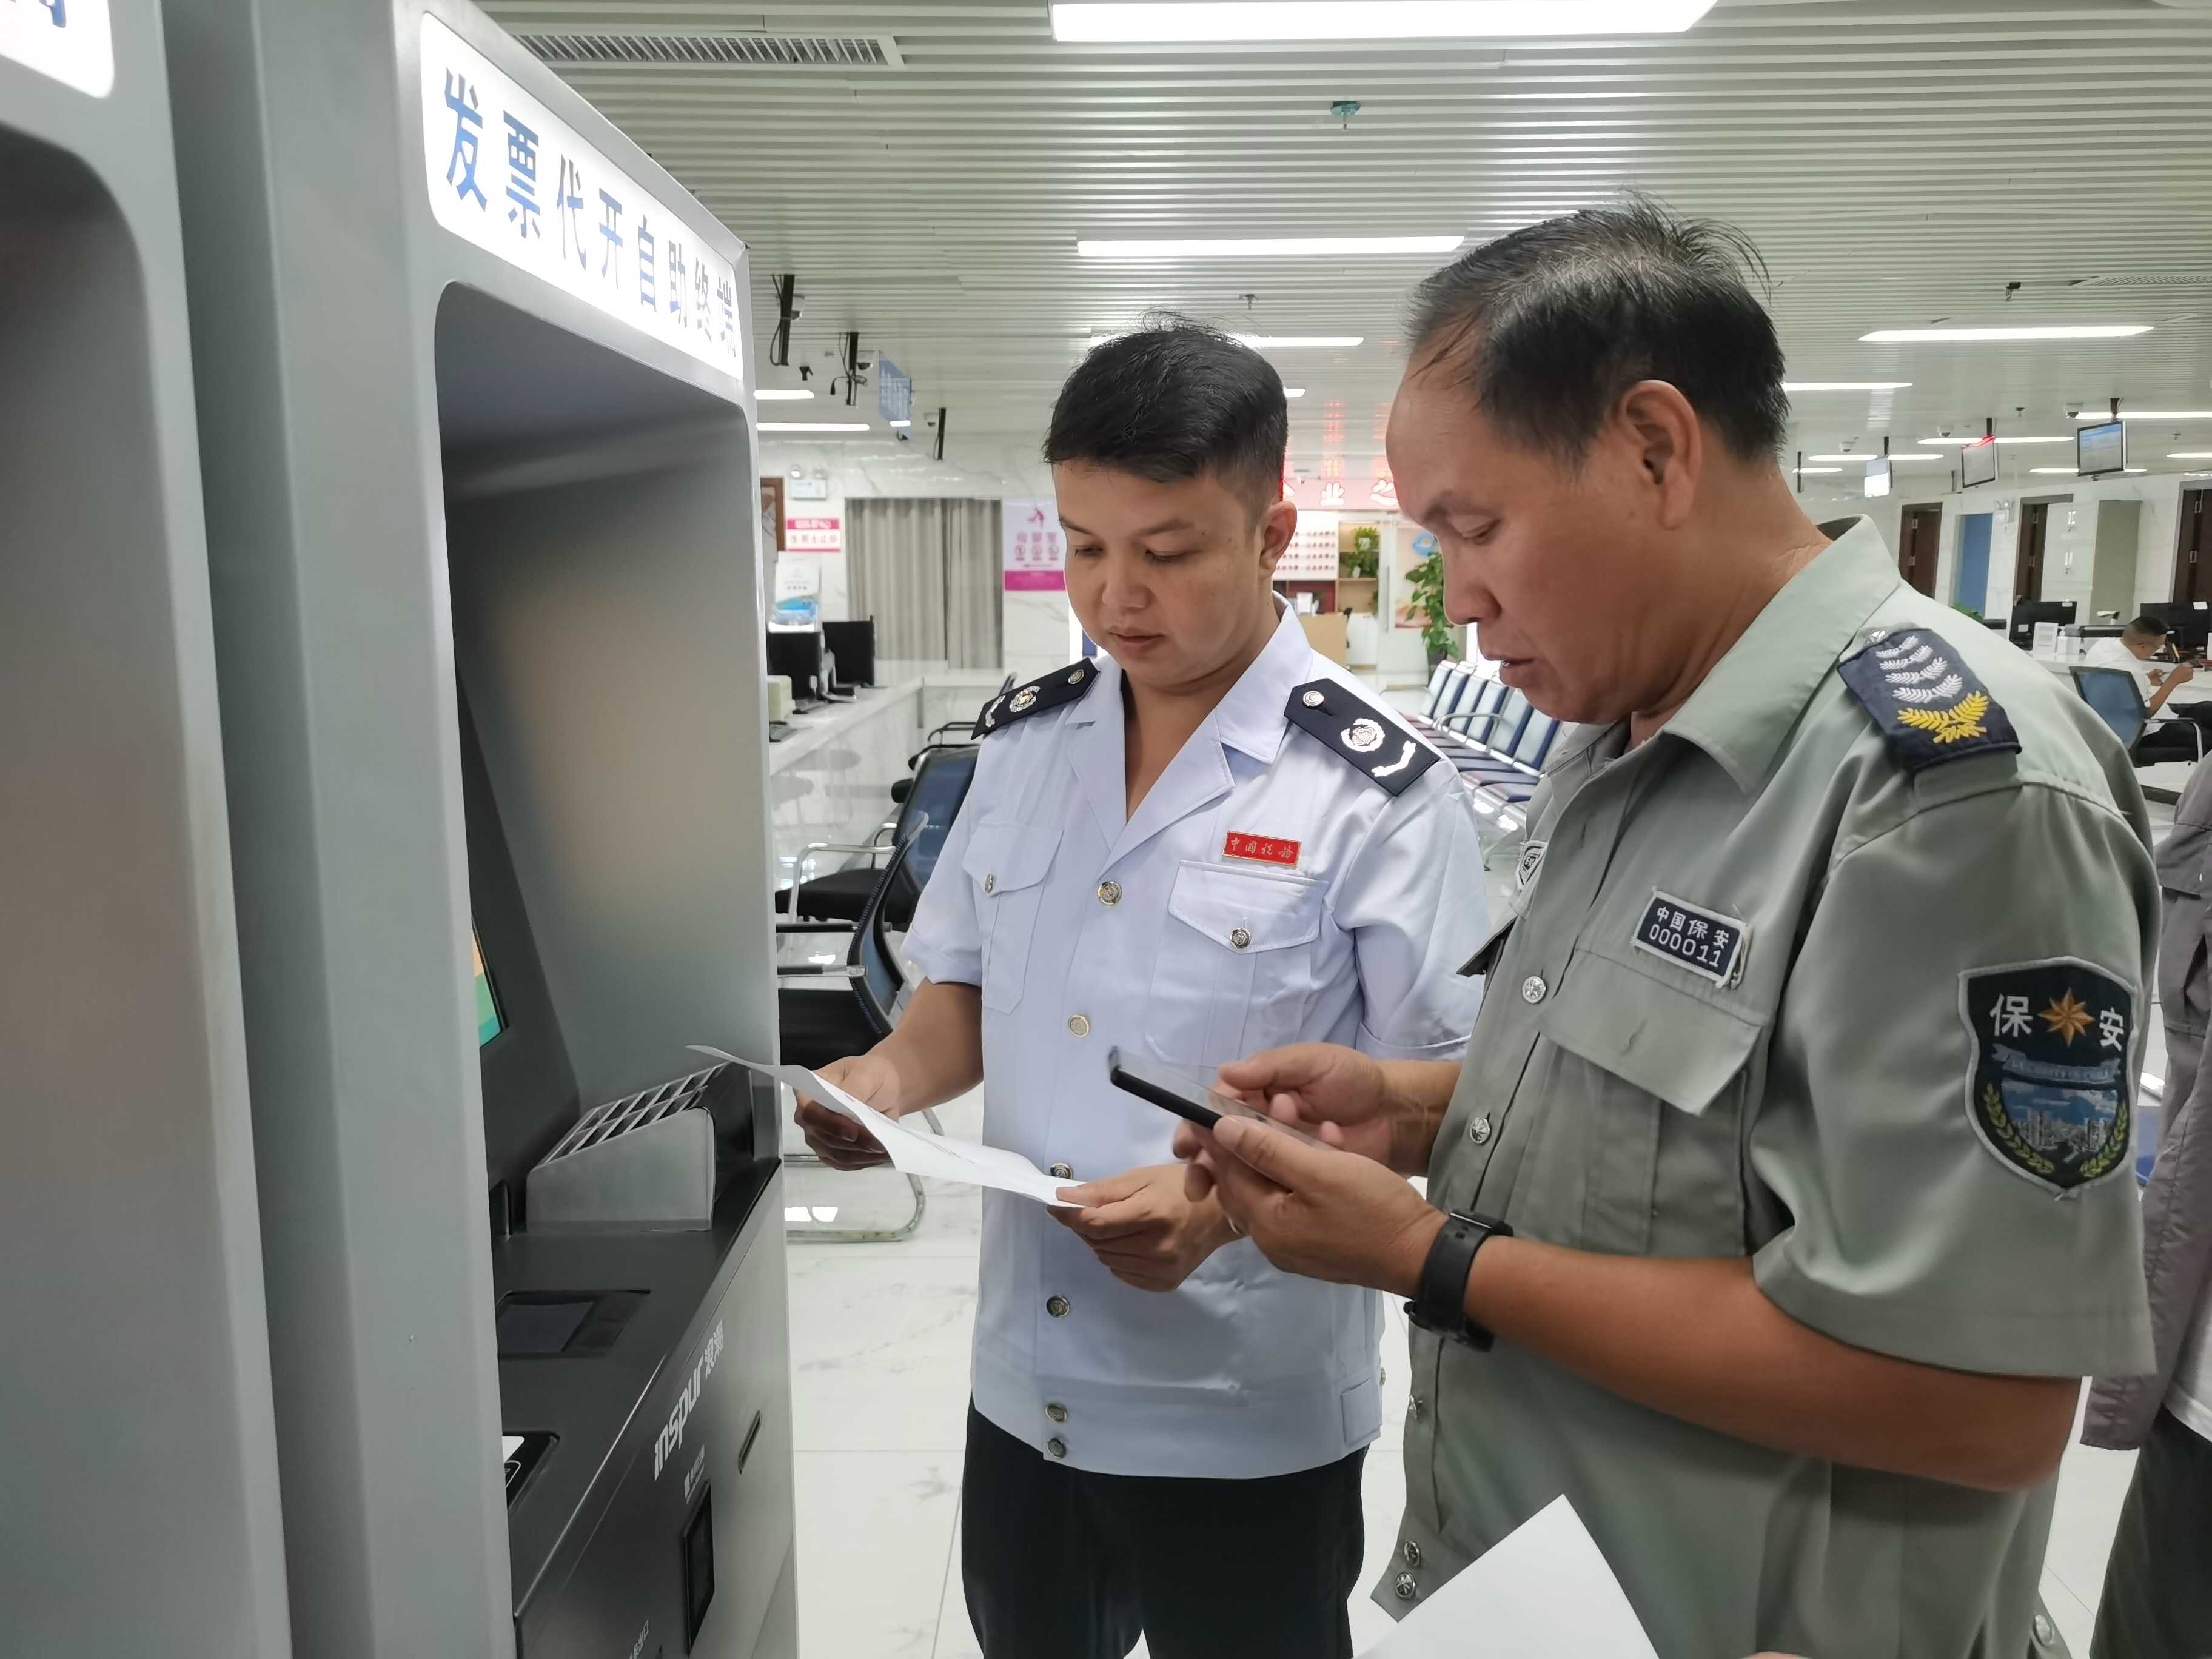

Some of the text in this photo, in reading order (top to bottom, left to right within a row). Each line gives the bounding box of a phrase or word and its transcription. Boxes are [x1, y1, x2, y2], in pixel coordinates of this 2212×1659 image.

[444, 67, 736, 358] 发票代开自助终端
[1649, 923, 1721, 968] 000011
[1657, 906, 1730, 949] 中国保安
[654, 1355, 703, 1482] inspur
